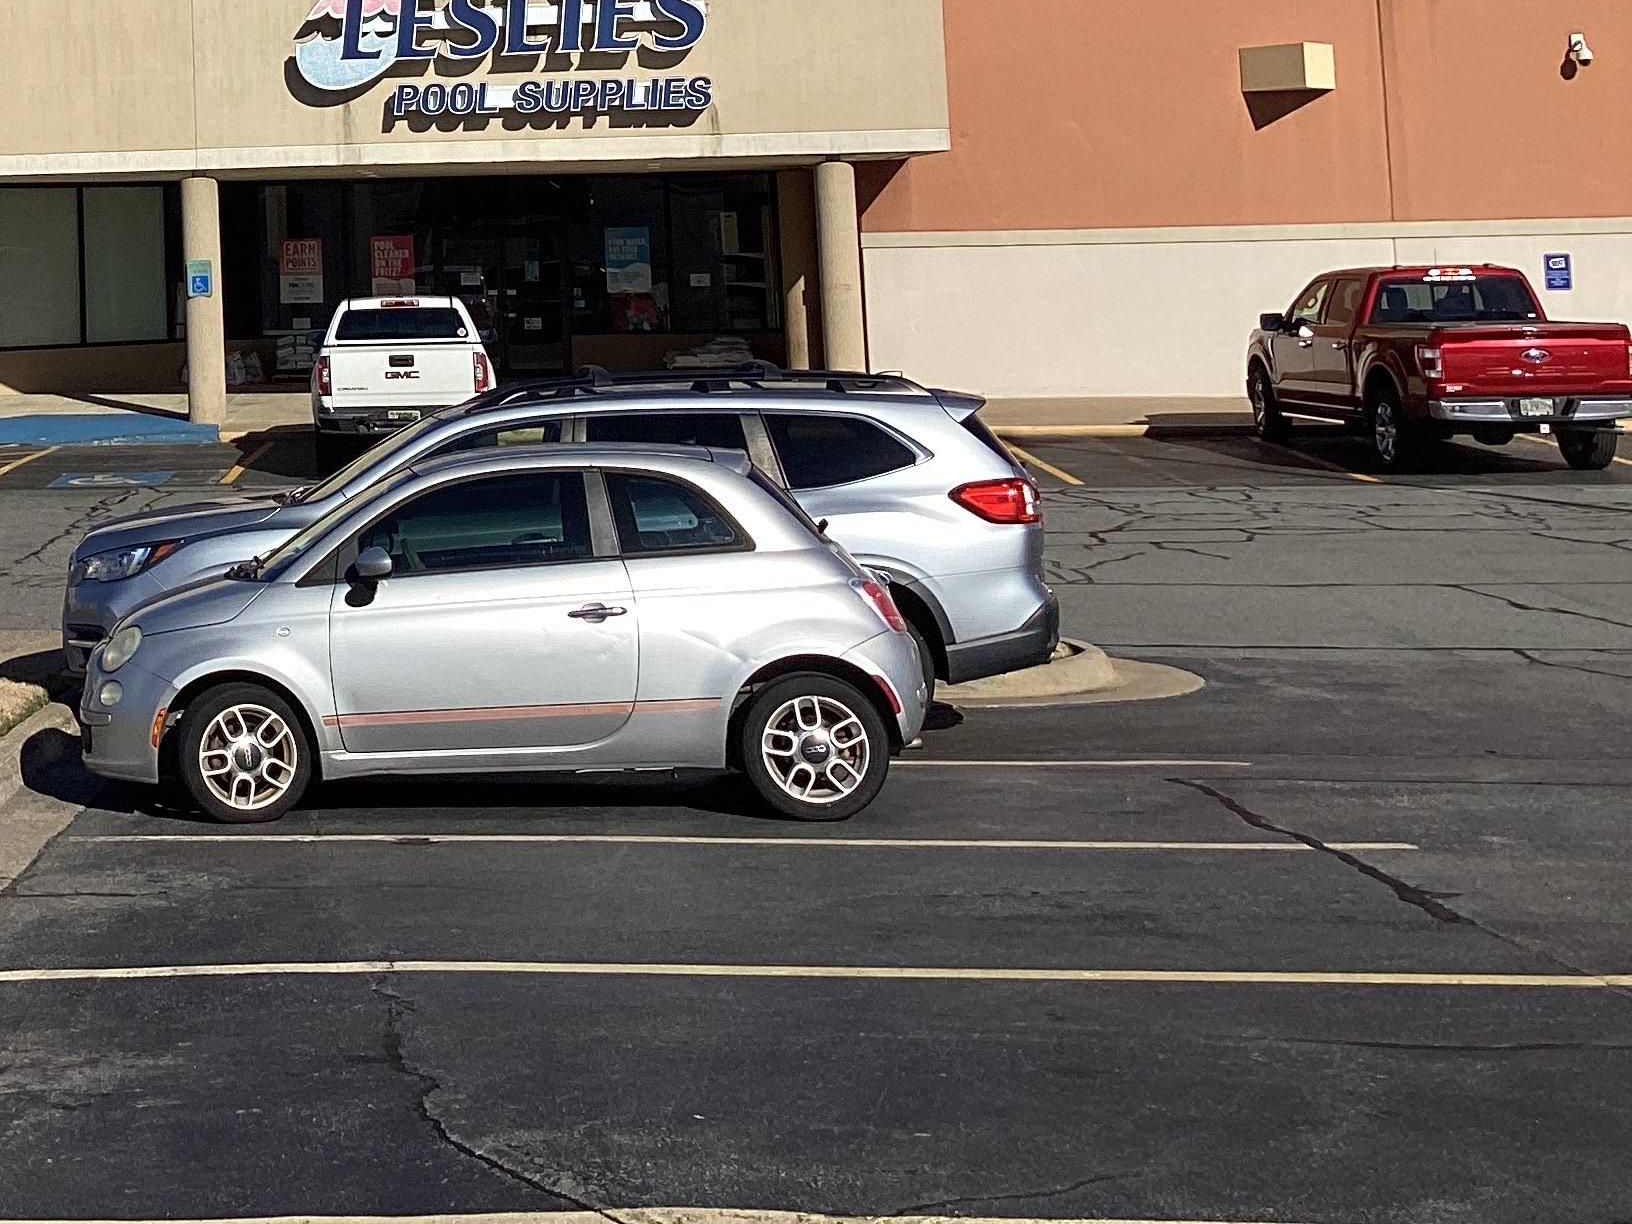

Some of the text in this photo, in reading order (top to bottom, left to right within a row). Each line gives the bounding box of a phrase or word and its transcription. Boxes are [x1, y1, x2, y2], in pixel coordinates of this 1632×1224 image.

[393, 76, 714, 116] POOL SUPPLIES
[285, 242, 316, 256] EARN
[285, 257, 317, 268] POINTS
[385, 371, 420, 380] GMC
